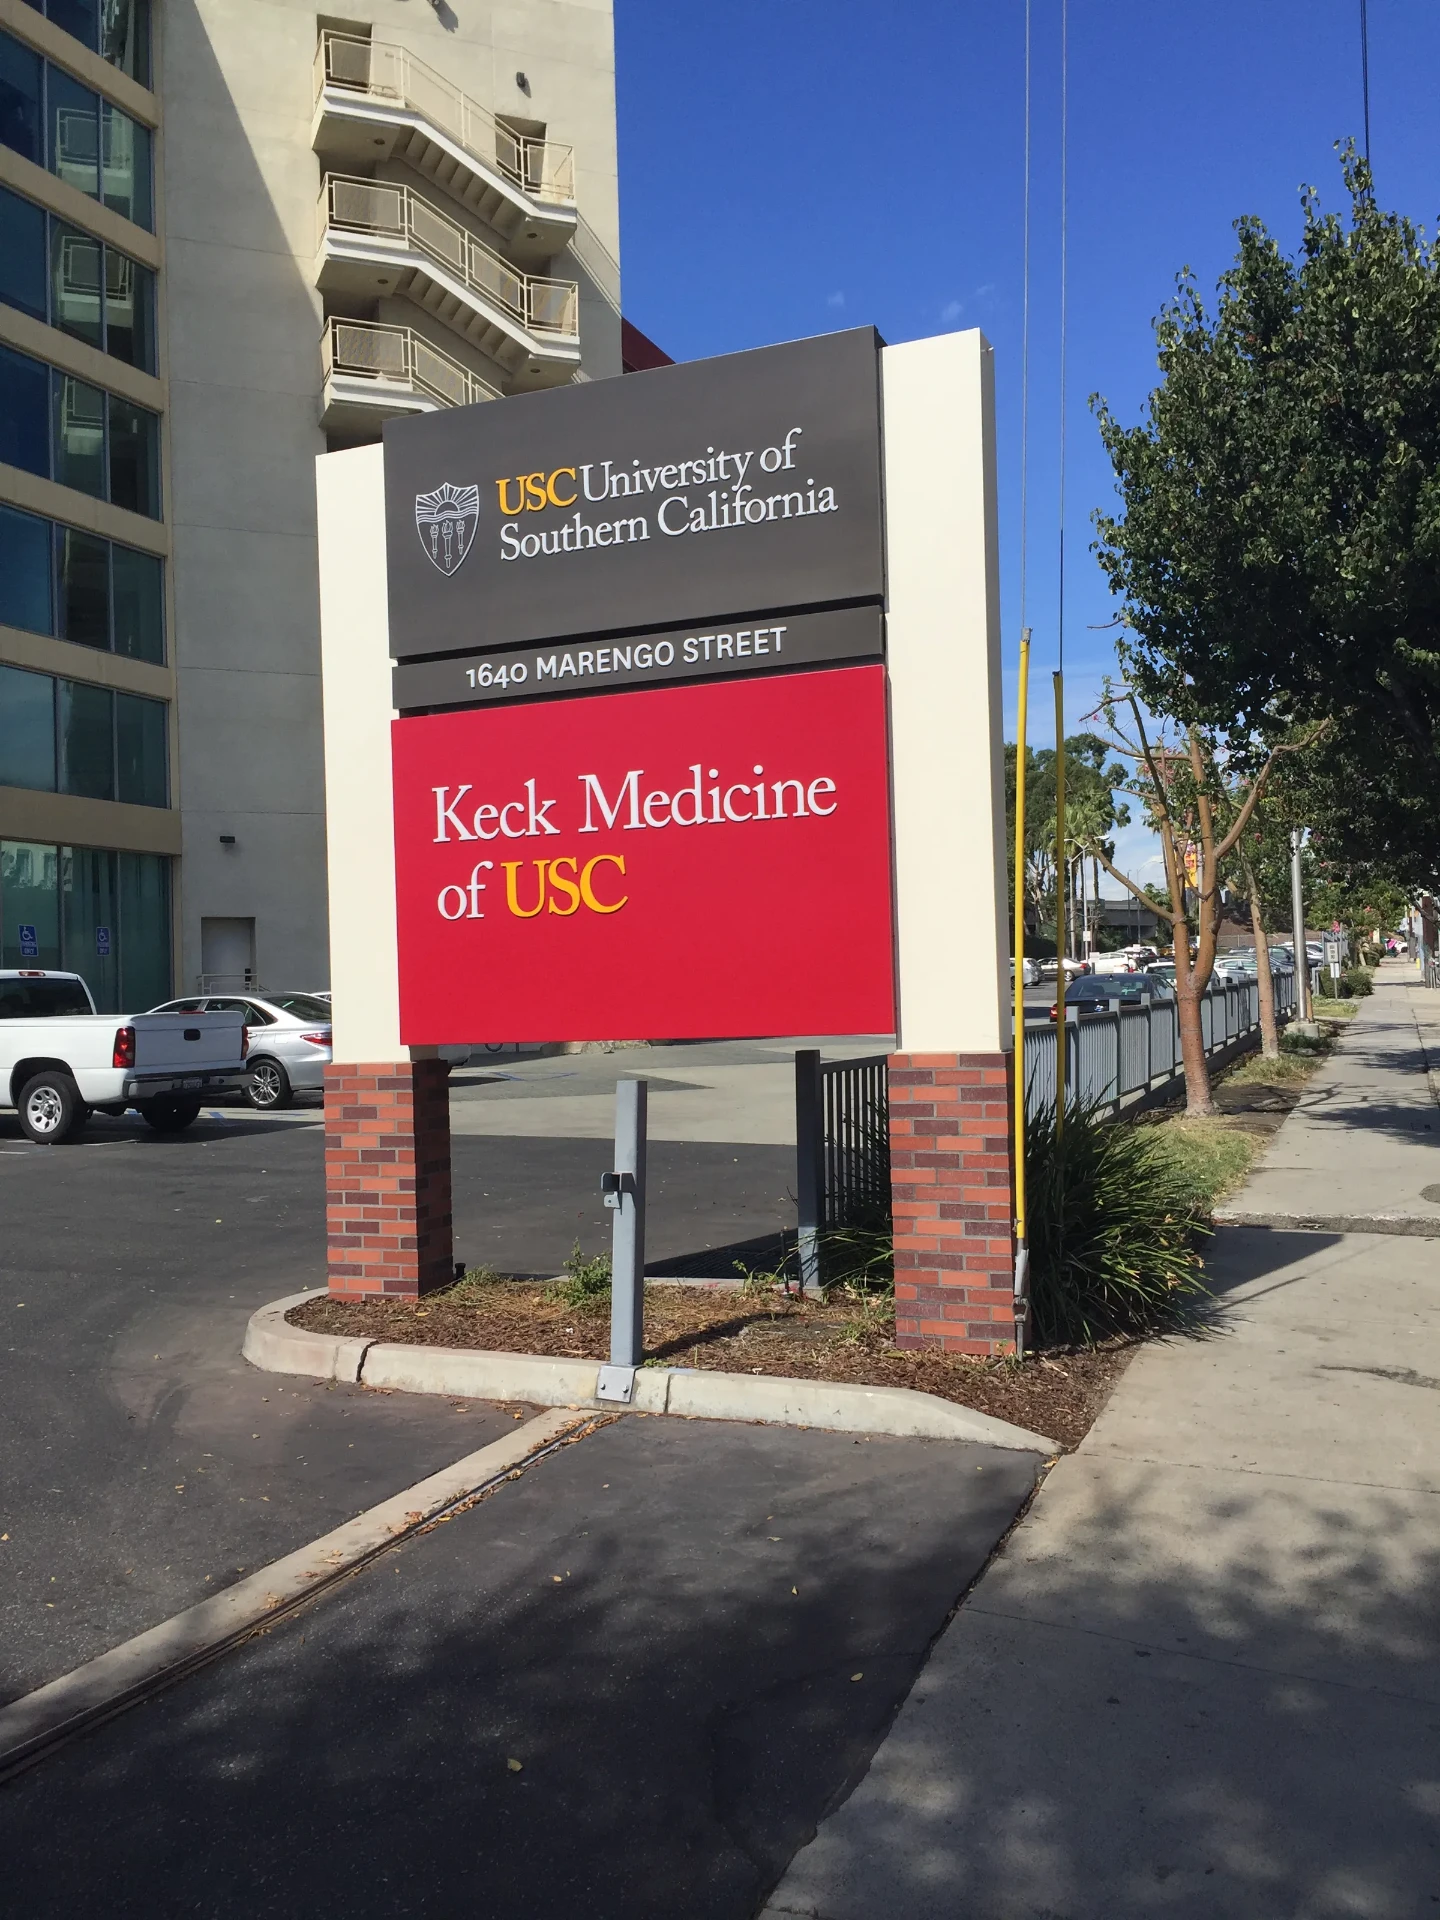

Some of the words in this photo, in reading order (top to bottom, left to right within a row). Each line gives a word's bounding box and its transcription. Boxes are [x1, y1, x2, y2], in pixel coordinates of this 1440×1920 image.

[496, 468, 576, 514] USC
[579, 447, 754, 501] University
[760, 428, 802, 472] of
[501, 512, 650, 560] Southern
[658, 479, 838, 535] California
[466, 663, 527, 688] 1640
[537, 641, 674, 679] MARENGO
[683, 627, 786, 662] STREET
[432, 778, 560, 842] Keck
[578, 764, 837, 832] Medicine
[438, 861, 493, 919] of
[501, 855, 627, 916] USC
